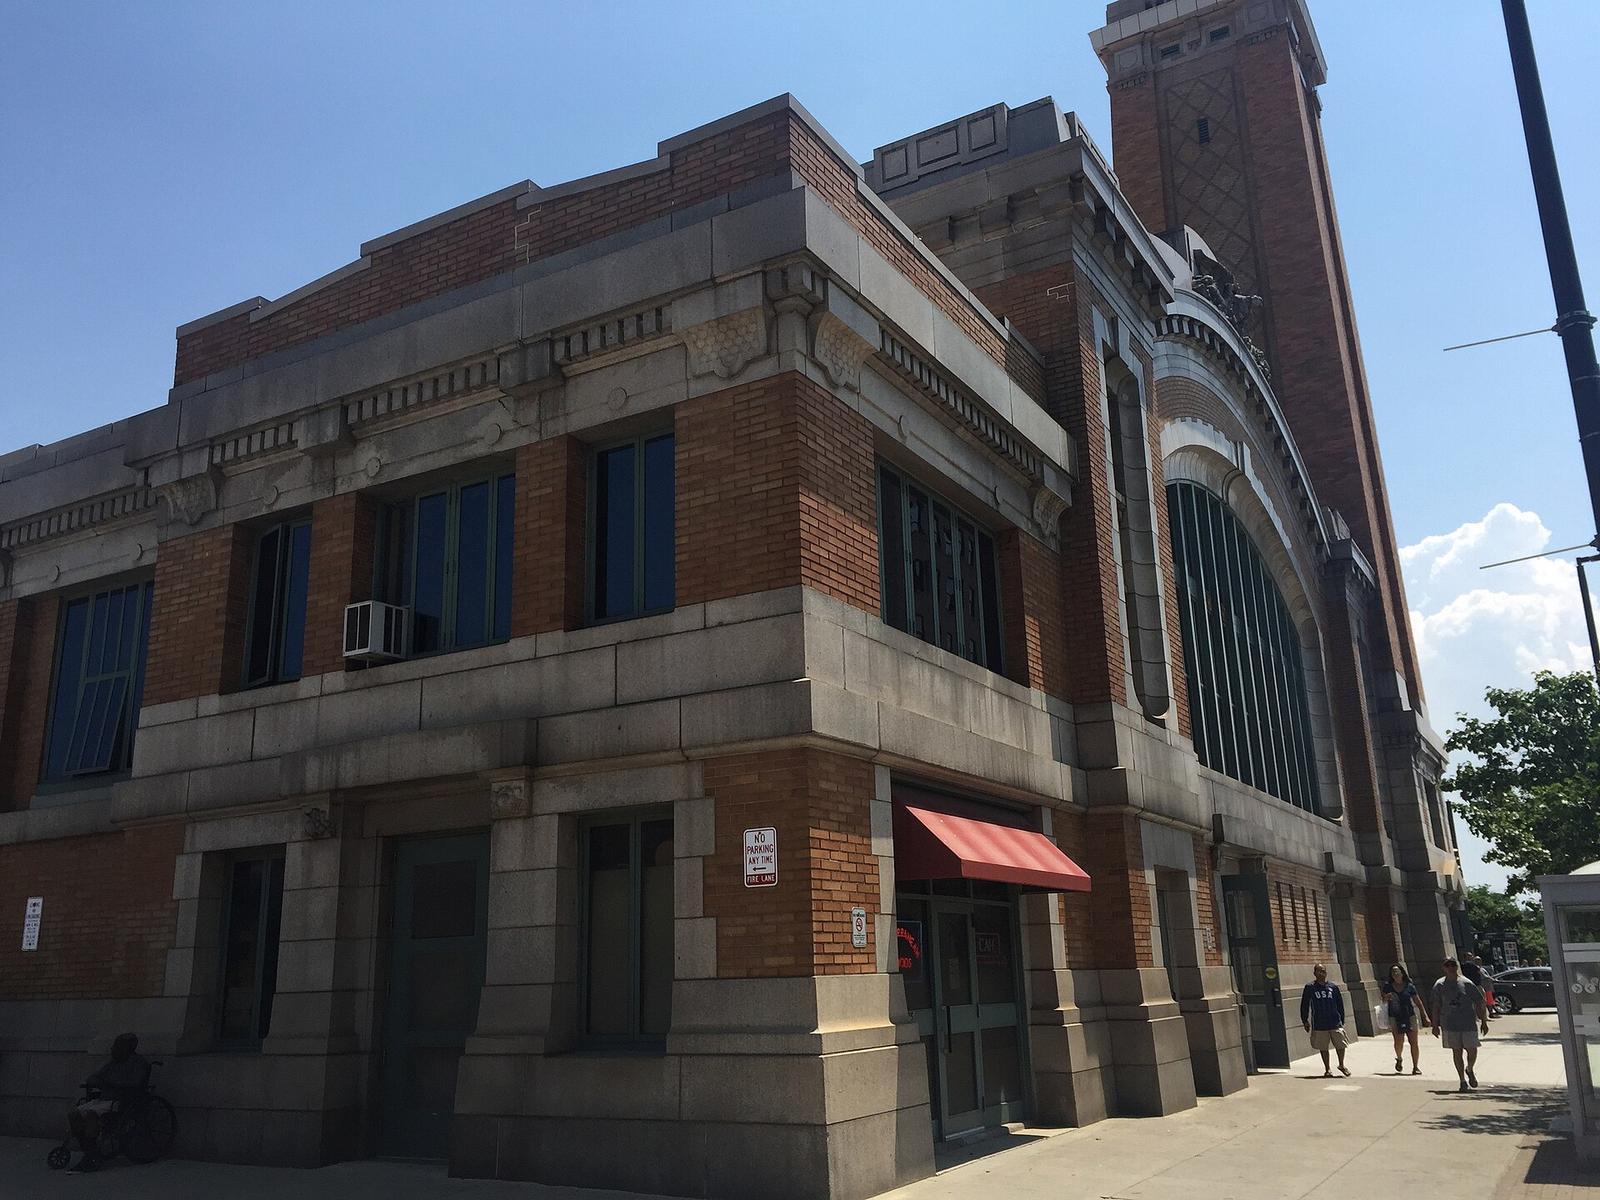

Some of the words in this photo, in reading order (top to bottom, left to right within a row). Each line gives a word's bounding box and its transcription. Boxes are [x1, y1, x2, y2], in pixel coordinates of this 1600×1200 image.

[754, 833, 766, 843] NO
[747, 844, 774, 854] PARKING
[761, 855, 773, 863] TIME
[761, 874, 775, 882] LANE
[1314, 990, 1333, 999] USA
